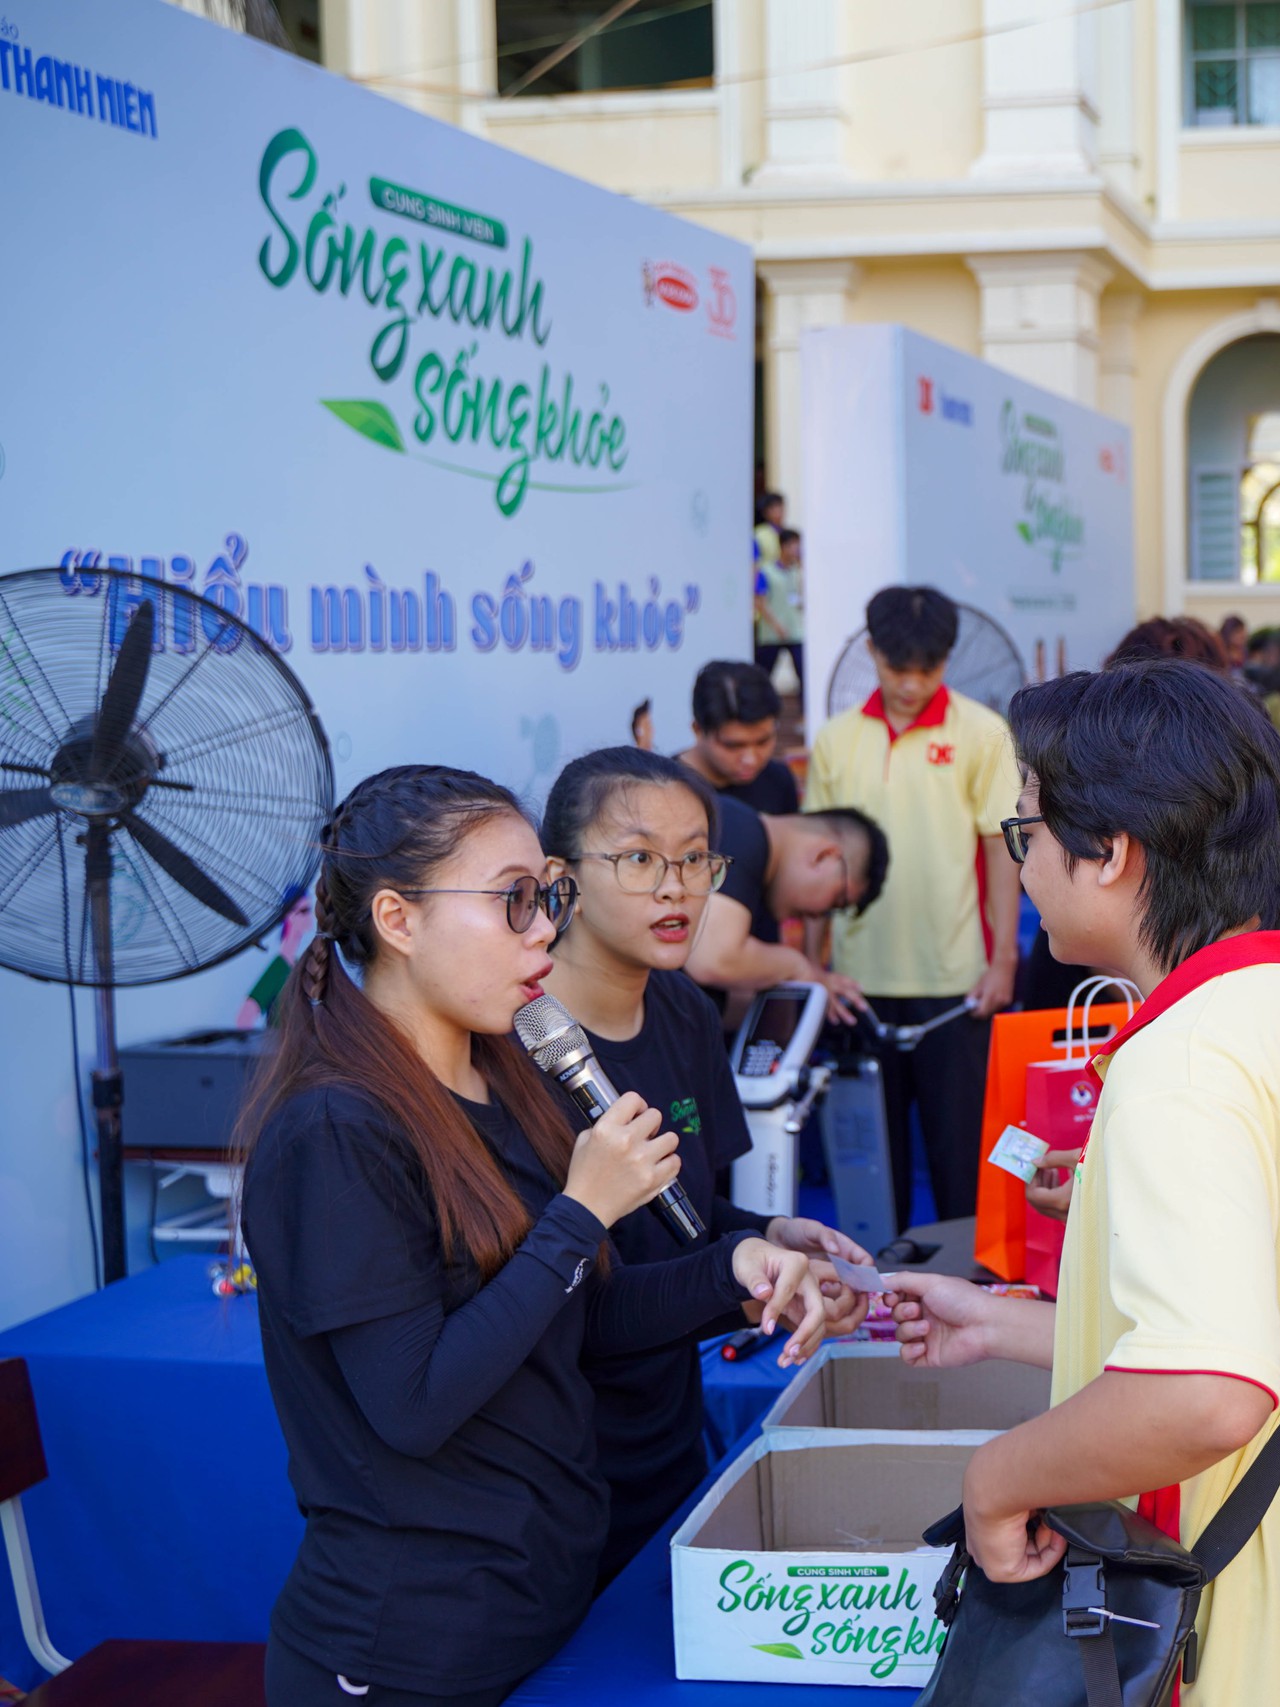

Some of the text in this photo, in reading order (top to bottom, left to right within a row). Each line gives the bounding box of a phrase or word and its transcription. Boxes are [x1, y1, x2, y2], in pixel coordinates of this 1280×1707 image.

[426, 202, 461, 231] SINH
[308, 562, 456, 653] mình
[471, 559, 583, 673] sống
[828, 1568, 852, 1576] SINH
[903, 1615, 947, 1655] kh
